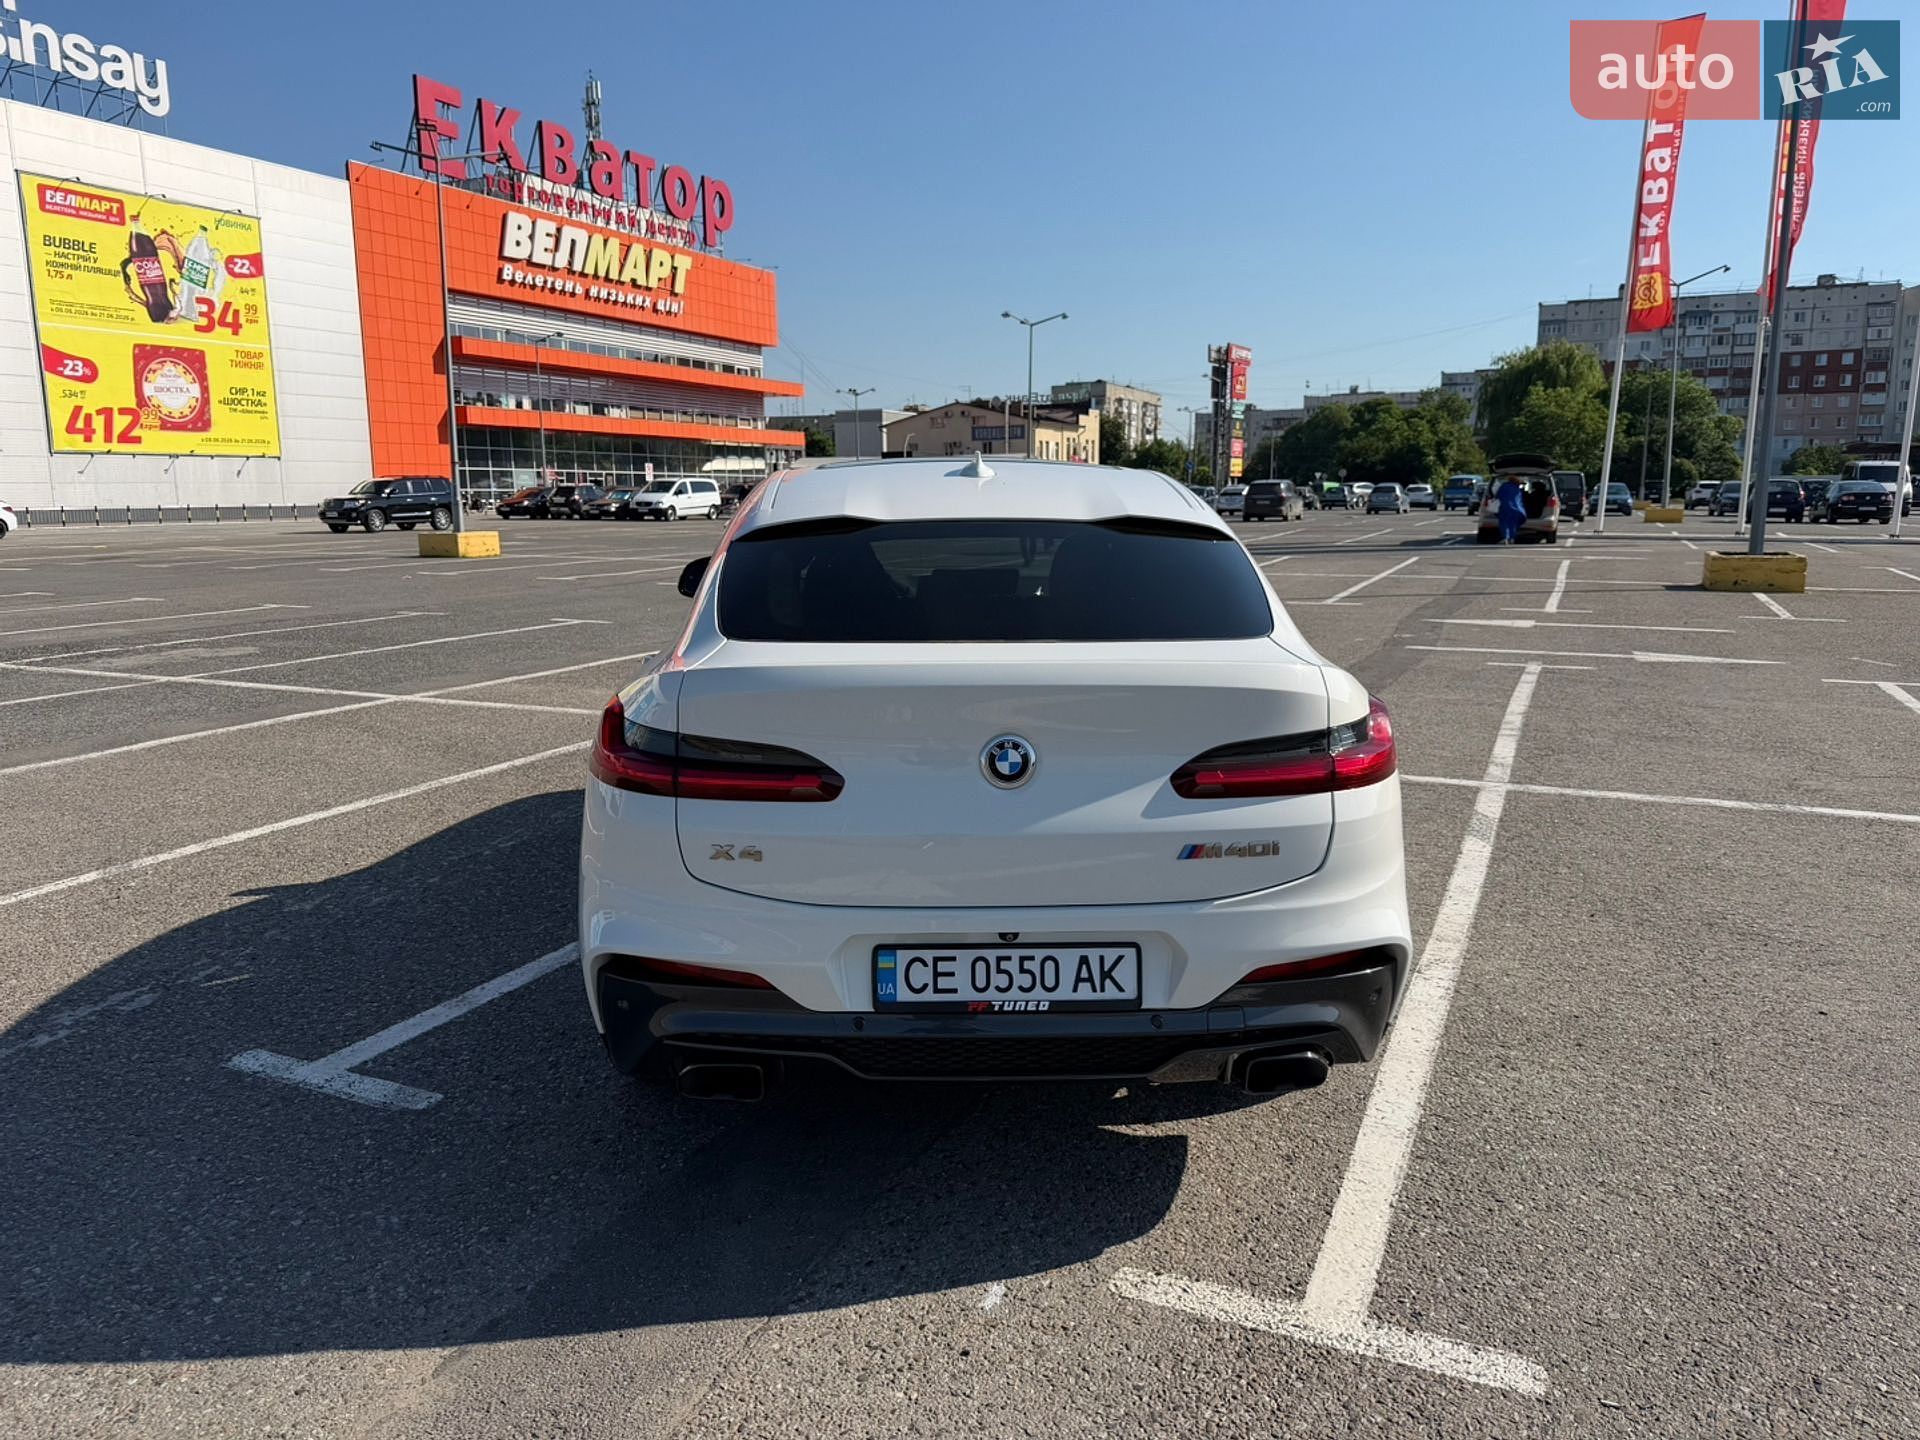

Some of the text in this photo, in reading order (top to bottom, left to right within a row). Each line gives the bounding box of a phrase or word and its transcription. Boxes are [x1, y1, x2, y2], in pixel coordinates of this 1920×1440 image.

[43, 234, 97, 254] BUBBLE
[501, 210, 693, 295] ВЕЛМАРТ
[46, 269, 65, 280] 1,75
[502, 264, 685, 316] Велетень низьких цін!
[194, 296, 243, 336] 34
[244, 303, 258, 315] 99
[235, 350, 264, 360] ТОВАР
[142, 408, 159, 420] 99
[65, 405, 143, 444] 412
[709, 843, 763, 863] X4
[904, 954, 1126, 995] CE 0550 AK
[878, 982, 895, 995] UA
